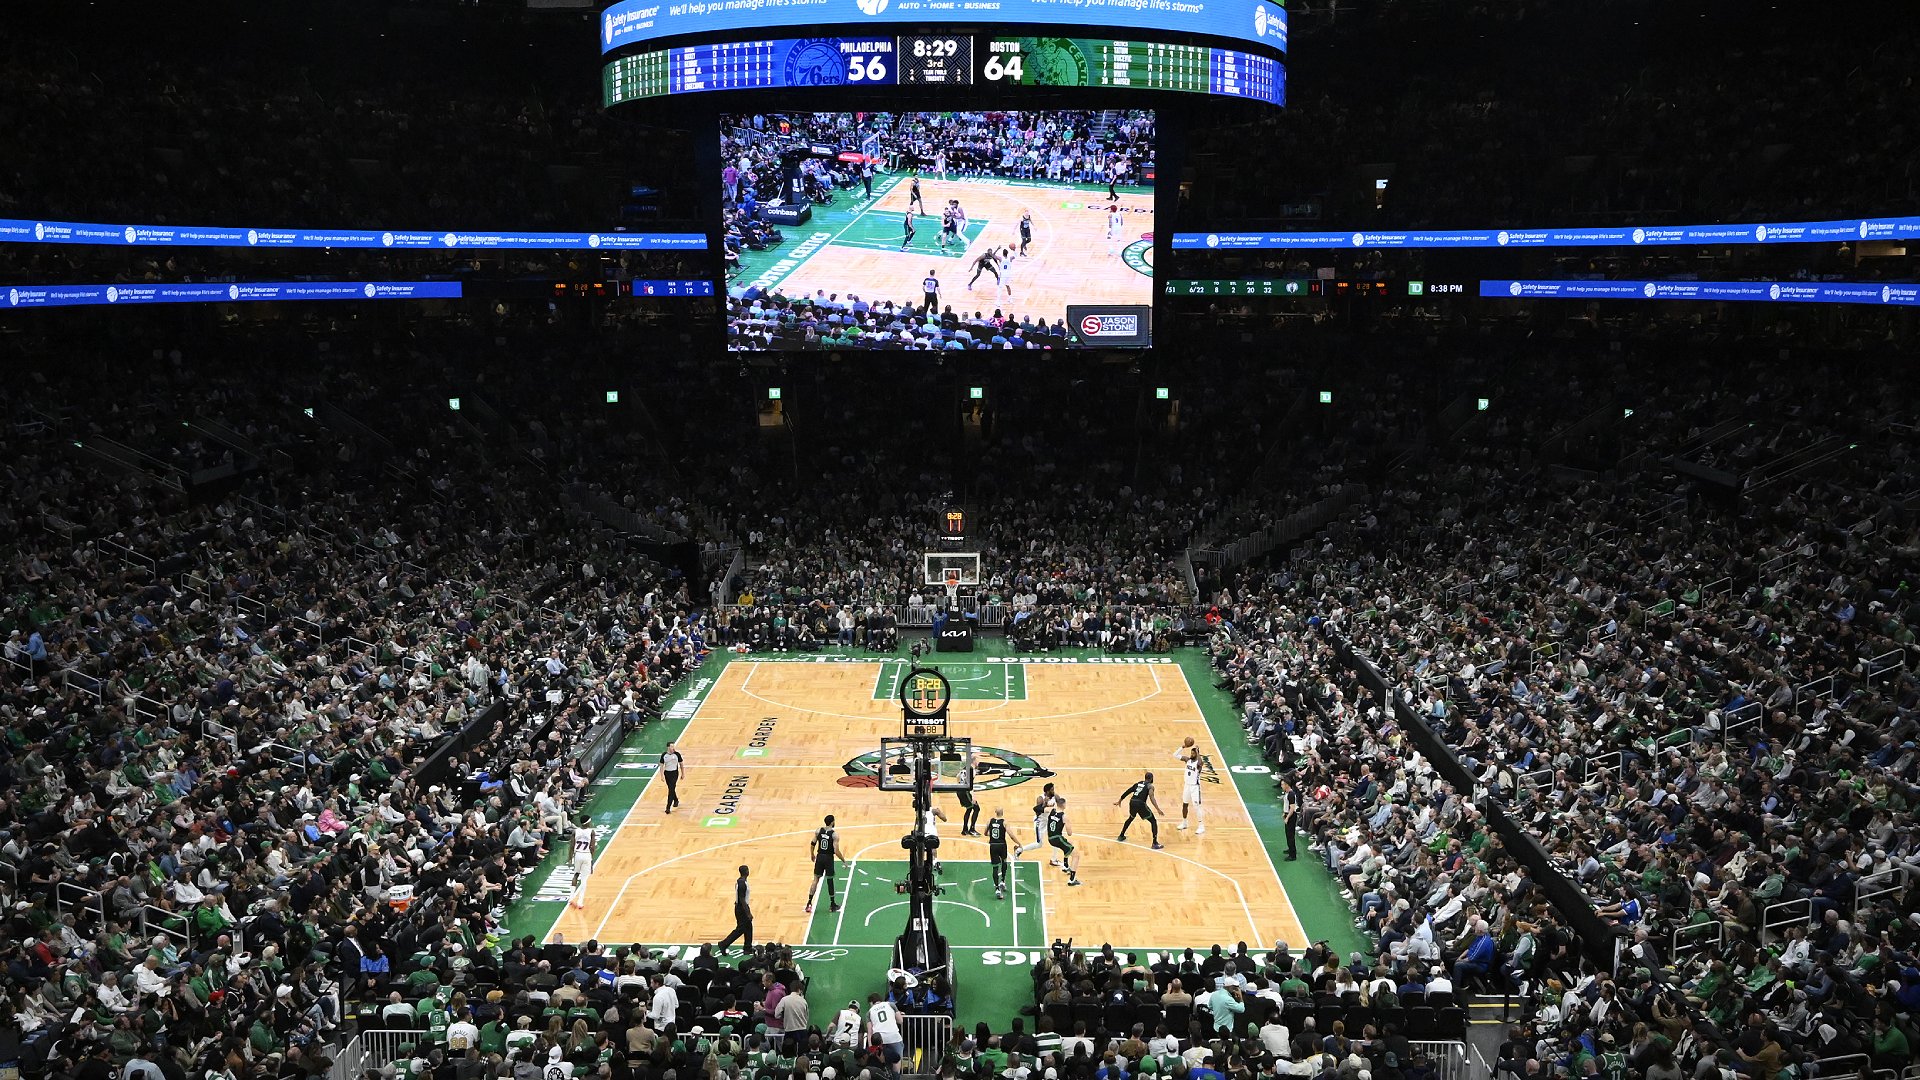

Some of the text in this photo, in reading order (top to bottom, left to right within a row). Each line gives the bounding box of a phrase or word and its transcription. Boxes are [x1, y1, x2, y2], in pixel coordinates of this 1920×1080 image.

[670, 4, 688, 16] We'll
[688, 3, 706, 15] help
[707, 2, 723, 14] you
[725, 0, 764, 11] manage
[1150, 0, 1170, 9] life's
[840, 42, 892, 53] PHILADELPHIA
[913, 40, 957, 57] 8:29
[990, 42, 1020, 52] BOSTON
[927, 59, 944, 68] 3rd
[848, 56, 887, 81] 56
[984, 56, 1023, 81] 64
[768, 208, 797, 216] coinbase
[137, 230, 151, 239] Safety
[258, 232, 271, 240] Safety
[1646, 230, 1662, 239] Safety
[1767, 228, 1782, 236] Safety
[395, 235, 409, 244] Safety
[601, 236, 616, 244] Safety
[1220, 236, 1236, 244] Safety
[1365, 234, 1380, 243] Safety
[1509, 233, 1525, 241] Safety
[788, 232, 832, 258] CELTICS
[239, 287, 254, 295] Safety
[376, 285, 391, 293] Safety
[1410, 284, 1422, 293] TD
[1430, 285, 1463, 293] 8:38 PM
[1522, 285, 1538, 293] Safety
[1781, 287, 1796, 295] Safety
[119, 289, 133, 298] Safety
[947, 512, 962, 521] 8:28
[949, 520, 961, 533] 11
[941, 630, 967, 638] KIA
[917, 678, 941, 690] 8:28
[749, 717, 778, 748] GARDEN
[714, 775, 749, 815] GARDEN
[991, 828, 1000, 840] 9
[576, 841, 590, 851] 77
[820, 838, 829, 851] 0
[878, 1010, 888, 1023] 0
[844, 1021, 854, 1034] 7
[1611, 1070, 1621, 1080] 11
